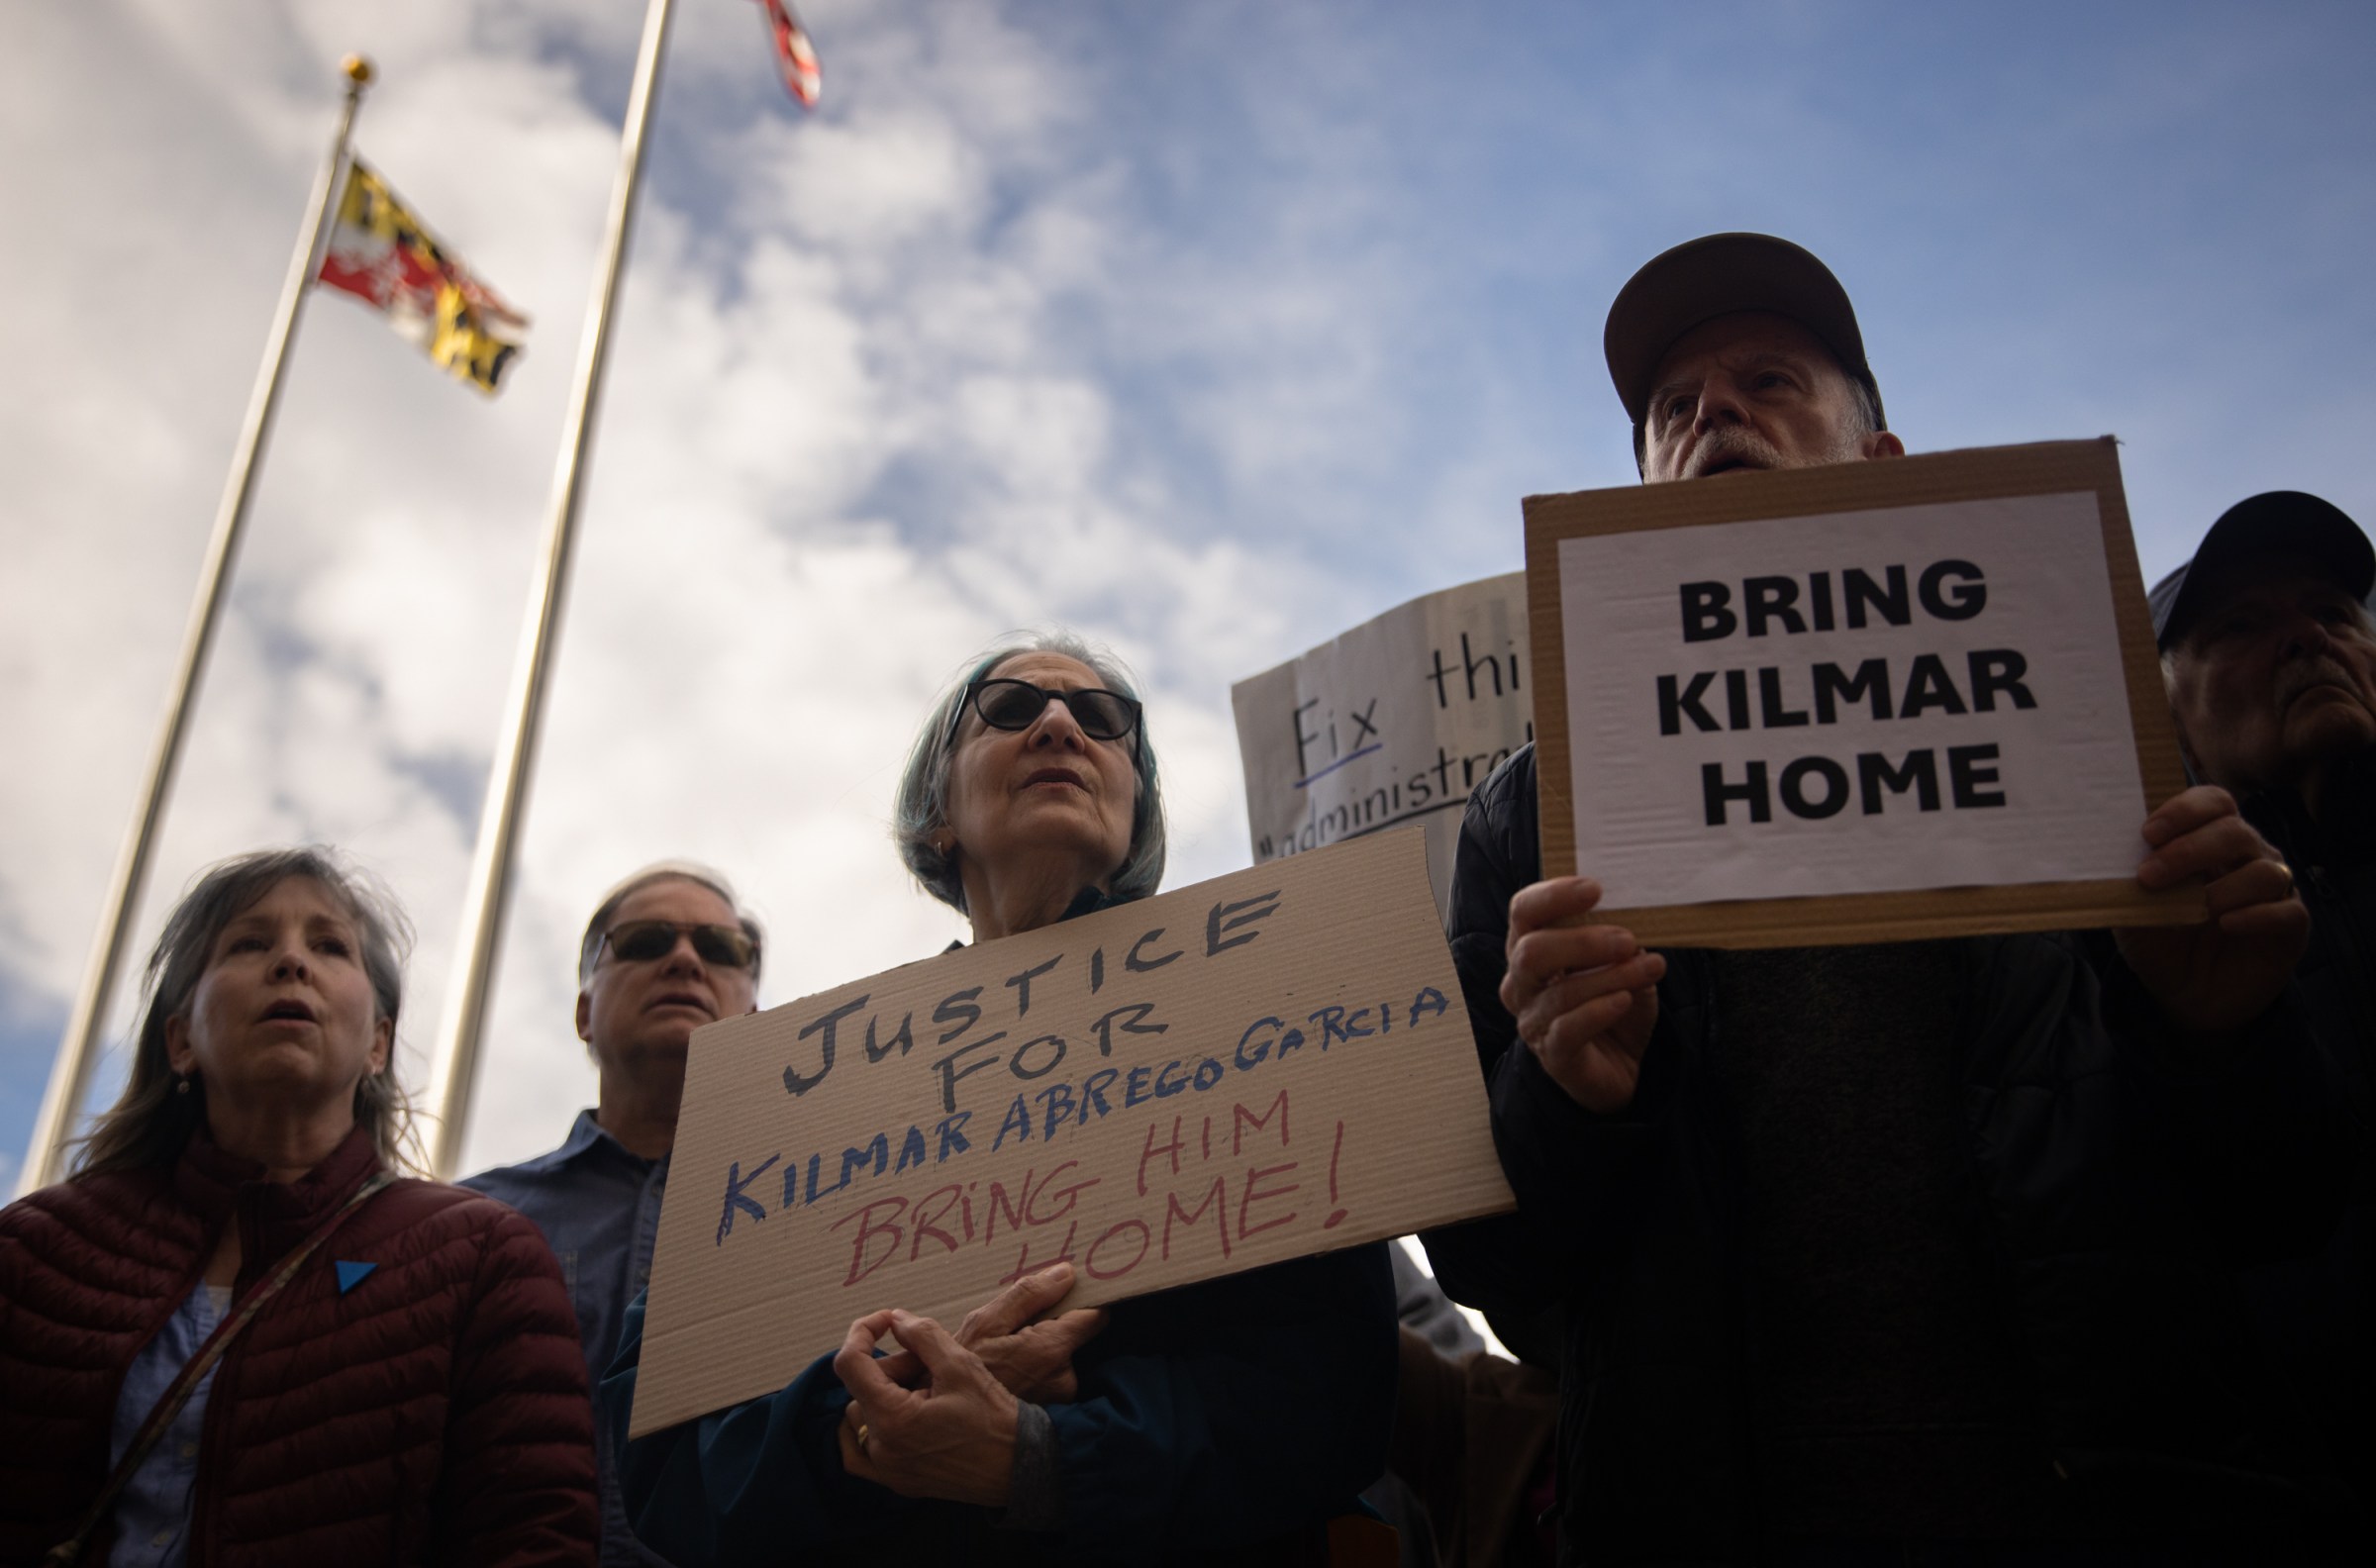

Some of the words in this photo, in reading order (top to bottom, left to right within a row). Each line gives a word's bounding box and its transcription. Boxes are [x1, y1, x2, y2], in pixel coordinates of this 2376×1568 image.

[1679, 558, 1987, 643] BRING
[1293, 697, 1378, 778] Fix
[1425, 632, 1519, 709] thi
[1656, 648, 2038, 736] KILMAR
[1701, 742, 2007, 827] HOME
[932, 1002, 1169, 1114] FOR
[717, 1111, 973, 1247] KILMAR
[992, 1057, 1225, 1153] ABREGO
[1234, 986, 1450, 1071] GARCIA
[1137, 1089, 1289, 1198] HIM
